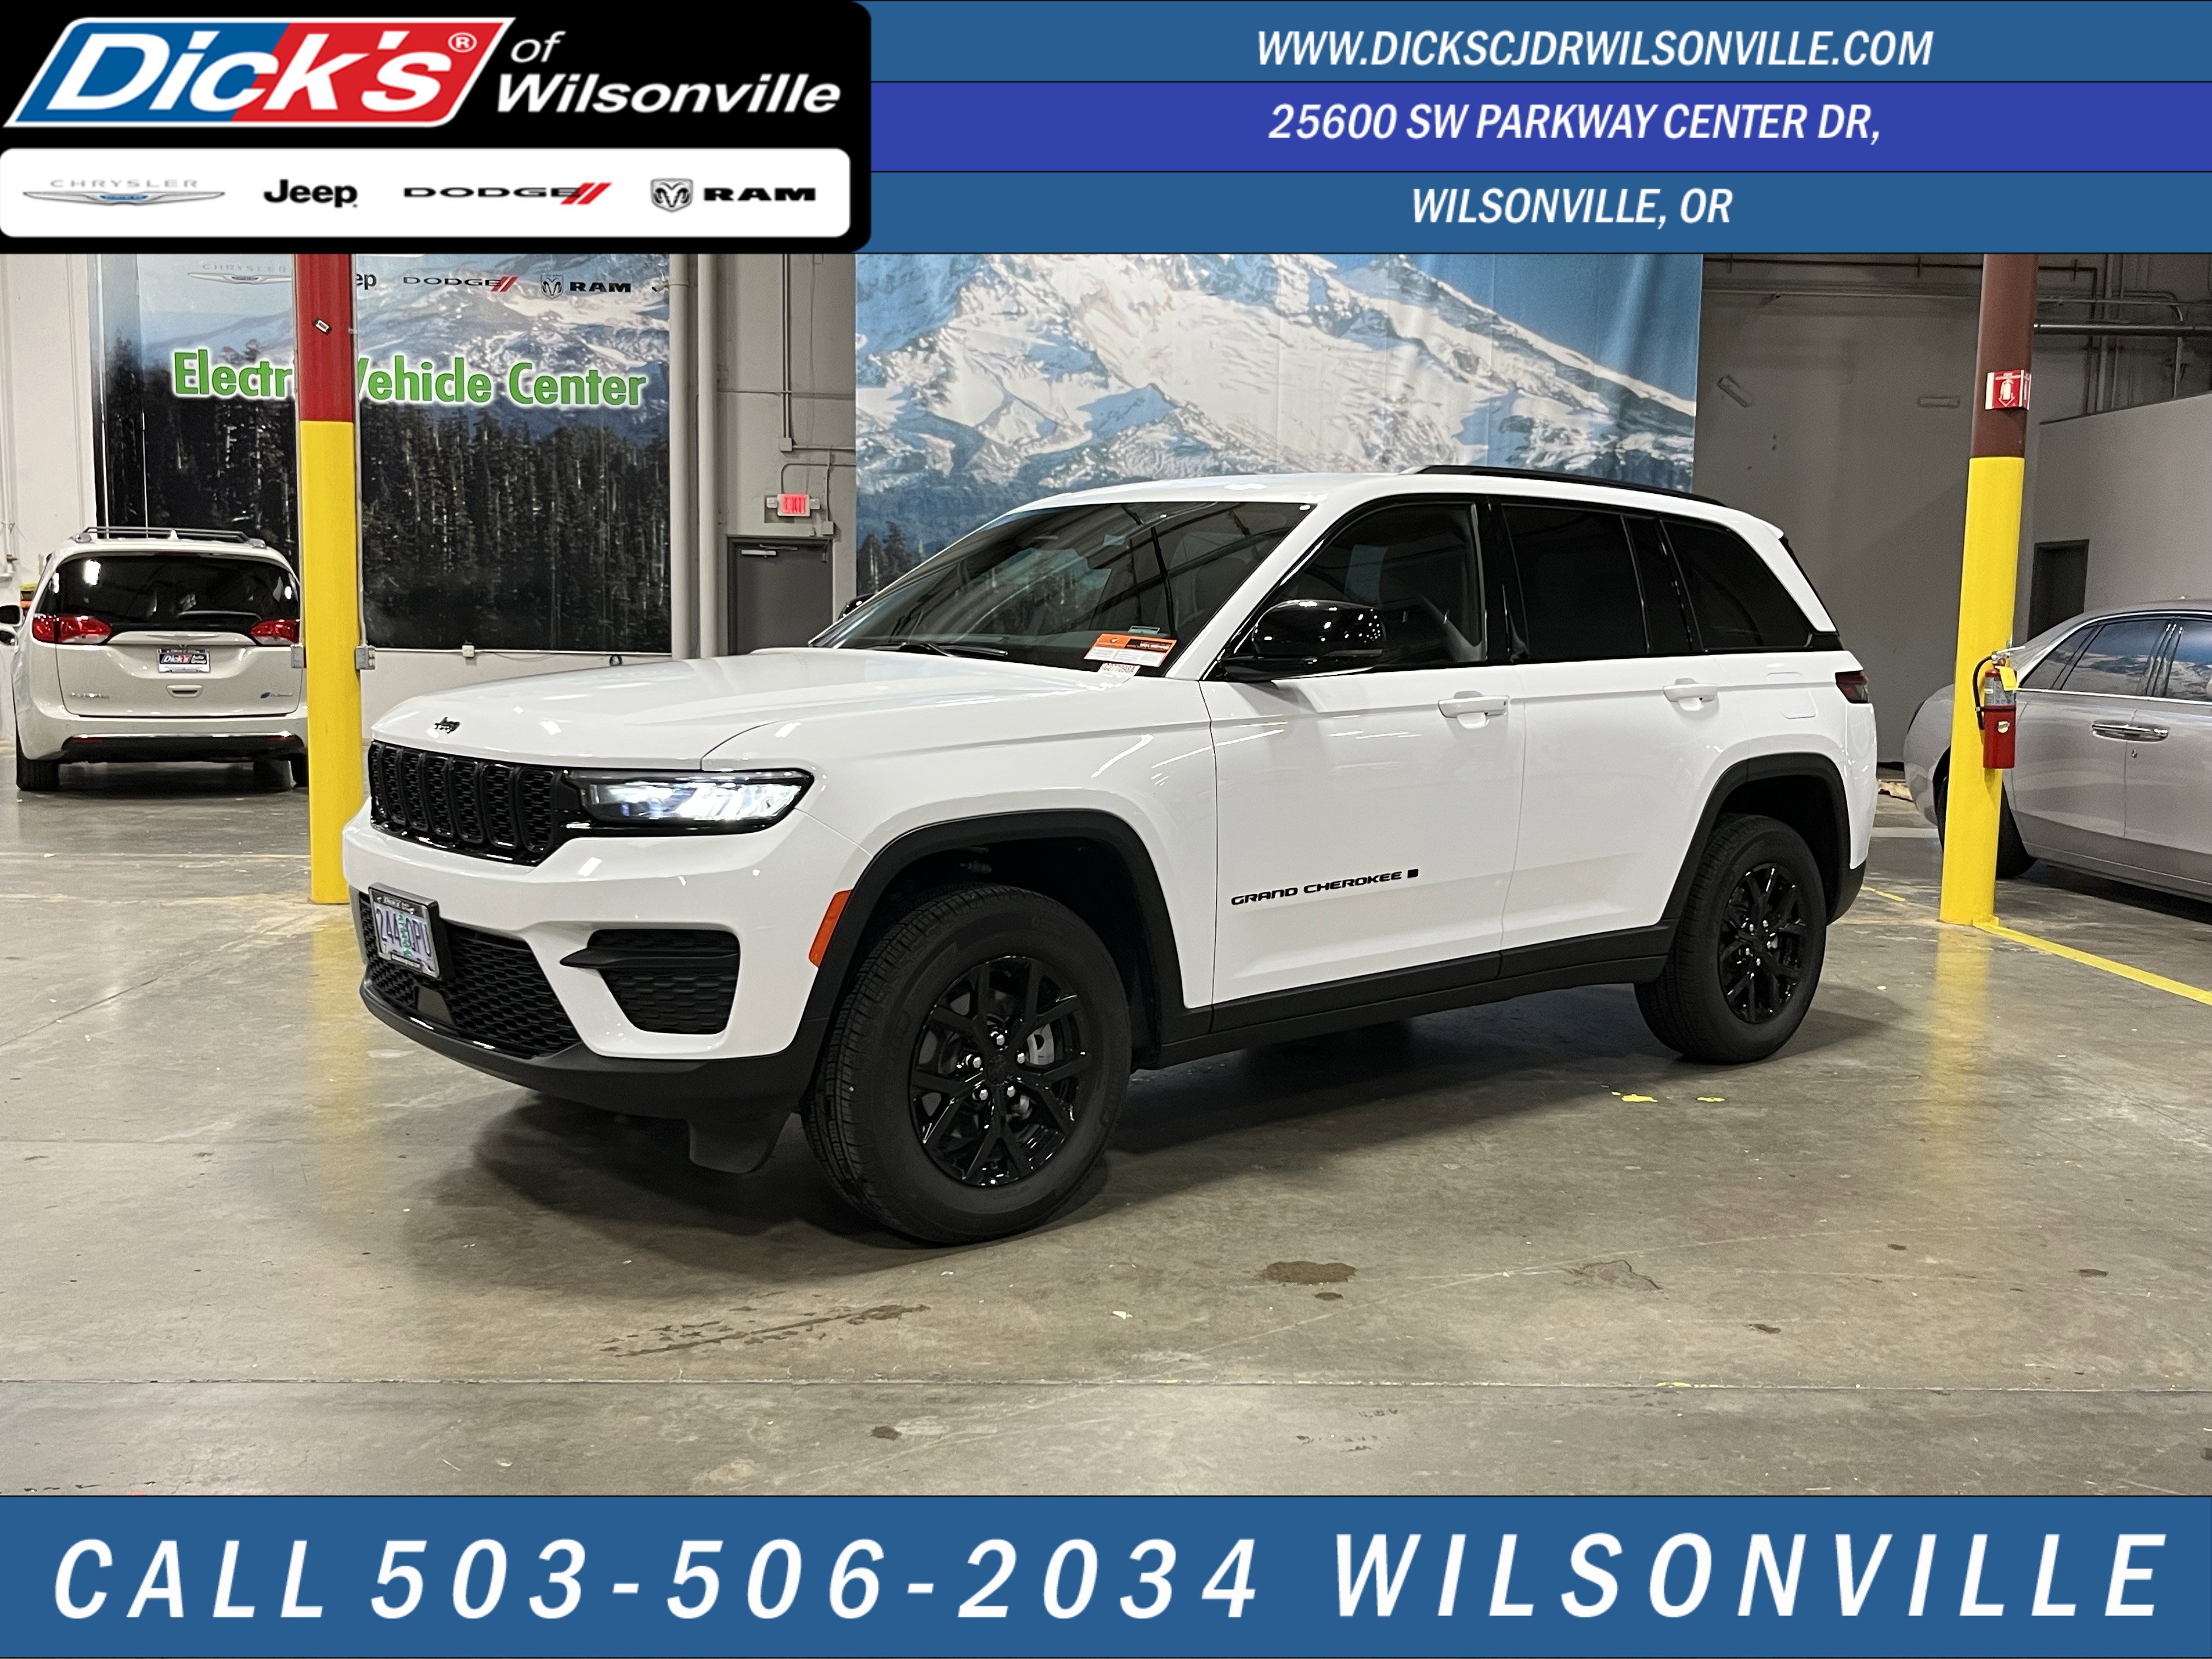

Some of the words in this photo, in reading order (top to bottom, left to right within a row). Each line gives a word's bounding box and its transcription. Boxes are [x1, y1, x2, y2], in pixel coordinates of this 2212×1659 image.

[356, 274, 377, 290] ep
[403, 276, 501, 287] DODGE
[569, 281, 631, 293] RAM
[174, 349, 293, 398] Electr
[510, 362, 646, 405] Center
[783, 494, 806, 514] EXIT
[1231, 887, 1299, 906] GRAND
[1303, 871, 1402, 894] CHEROKEE
[375, 907, 402, 948] 244
